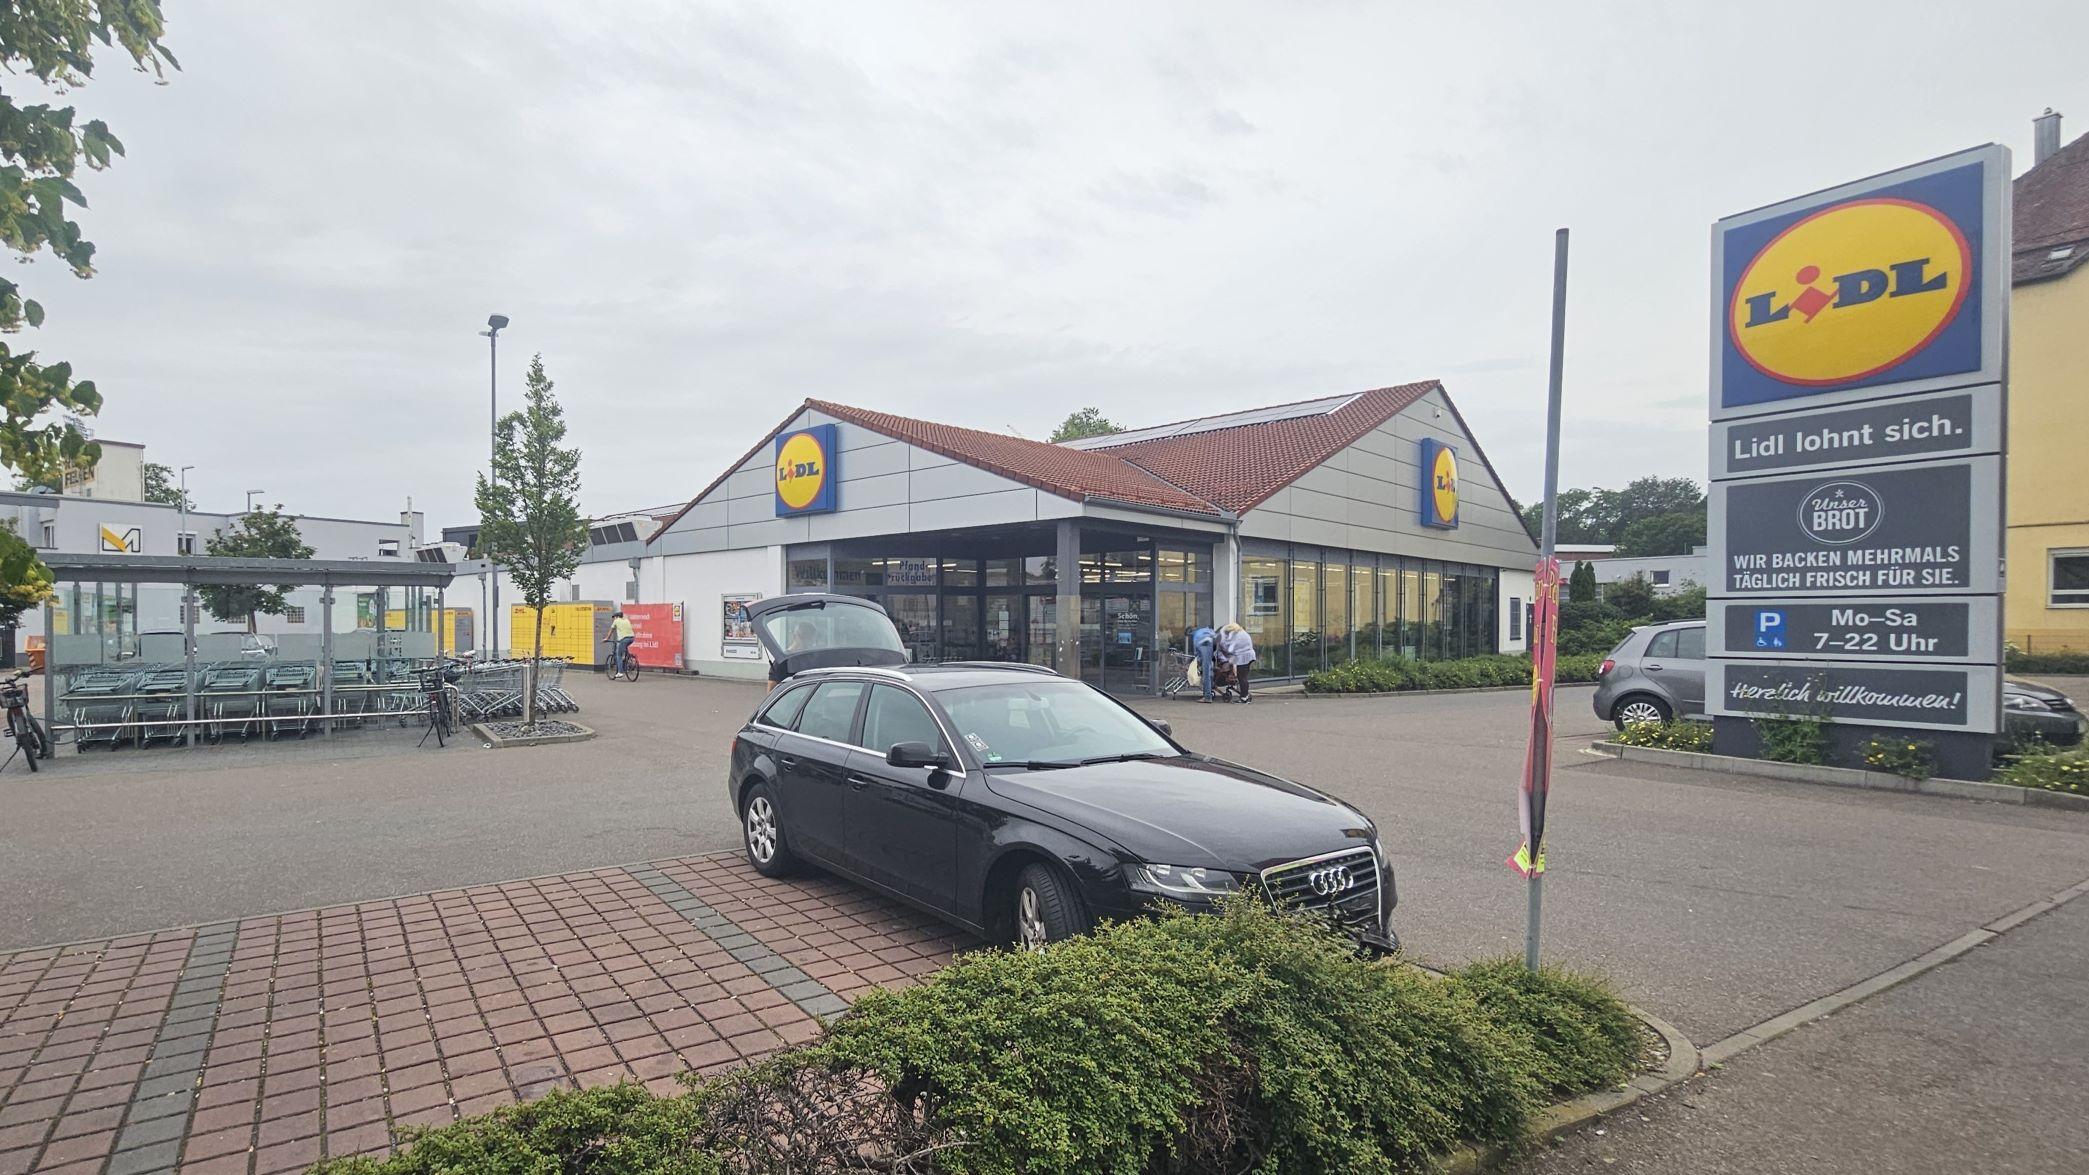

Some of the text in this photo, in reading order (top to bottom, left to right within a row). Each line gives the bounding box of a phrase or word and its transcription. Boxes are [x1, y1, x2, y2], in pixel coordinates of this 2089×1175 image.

[1734, 414, 1963, 460] Lidl lohnt sich.
[1811, 498, 1868, 511] Unser
[1812, 508, 1869, 531] BROT
[1733, 545, 1960, 570] WIR BACKEN MEHRMALS
[1733, 566, 1959, 589] TÄGLICH FRISCH FÜR SIE.
[1759, 612, 1781, 632] P
[1889, 633, 1938, 651] Uhr
[1730, 682, 1961, 710] Herzlich willkommen!
